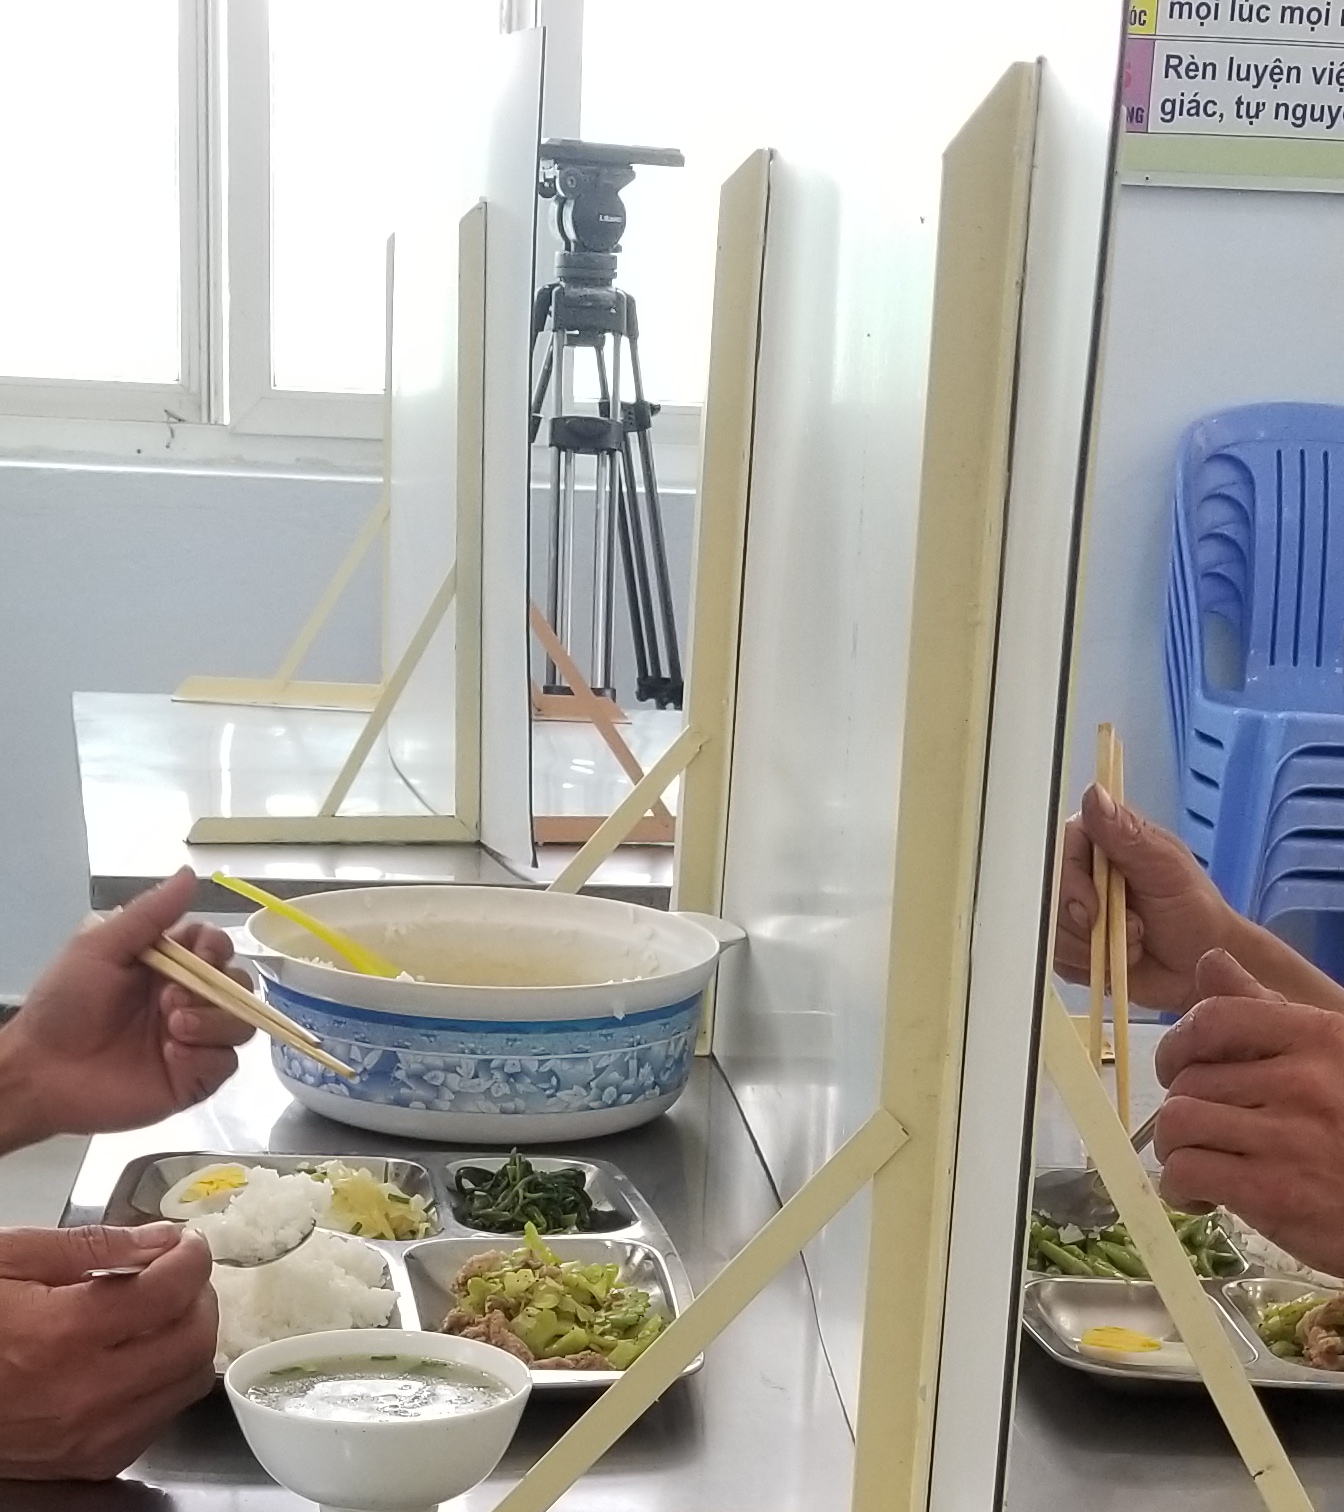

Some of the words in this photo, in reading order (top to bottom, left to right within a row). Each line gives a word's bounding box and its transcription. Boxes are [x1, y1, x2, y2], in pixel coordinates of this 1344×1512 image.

[1168, 0, 1220, 27] mọi
[1280, 0, 1331, 33] mọi
[1163, 53, 1218, 81] Rèn
[1227, 56, 1302, 90] luyện
[1159, 91, 1224, 124] giác,
[1235, 94, 1267, 126] tự
